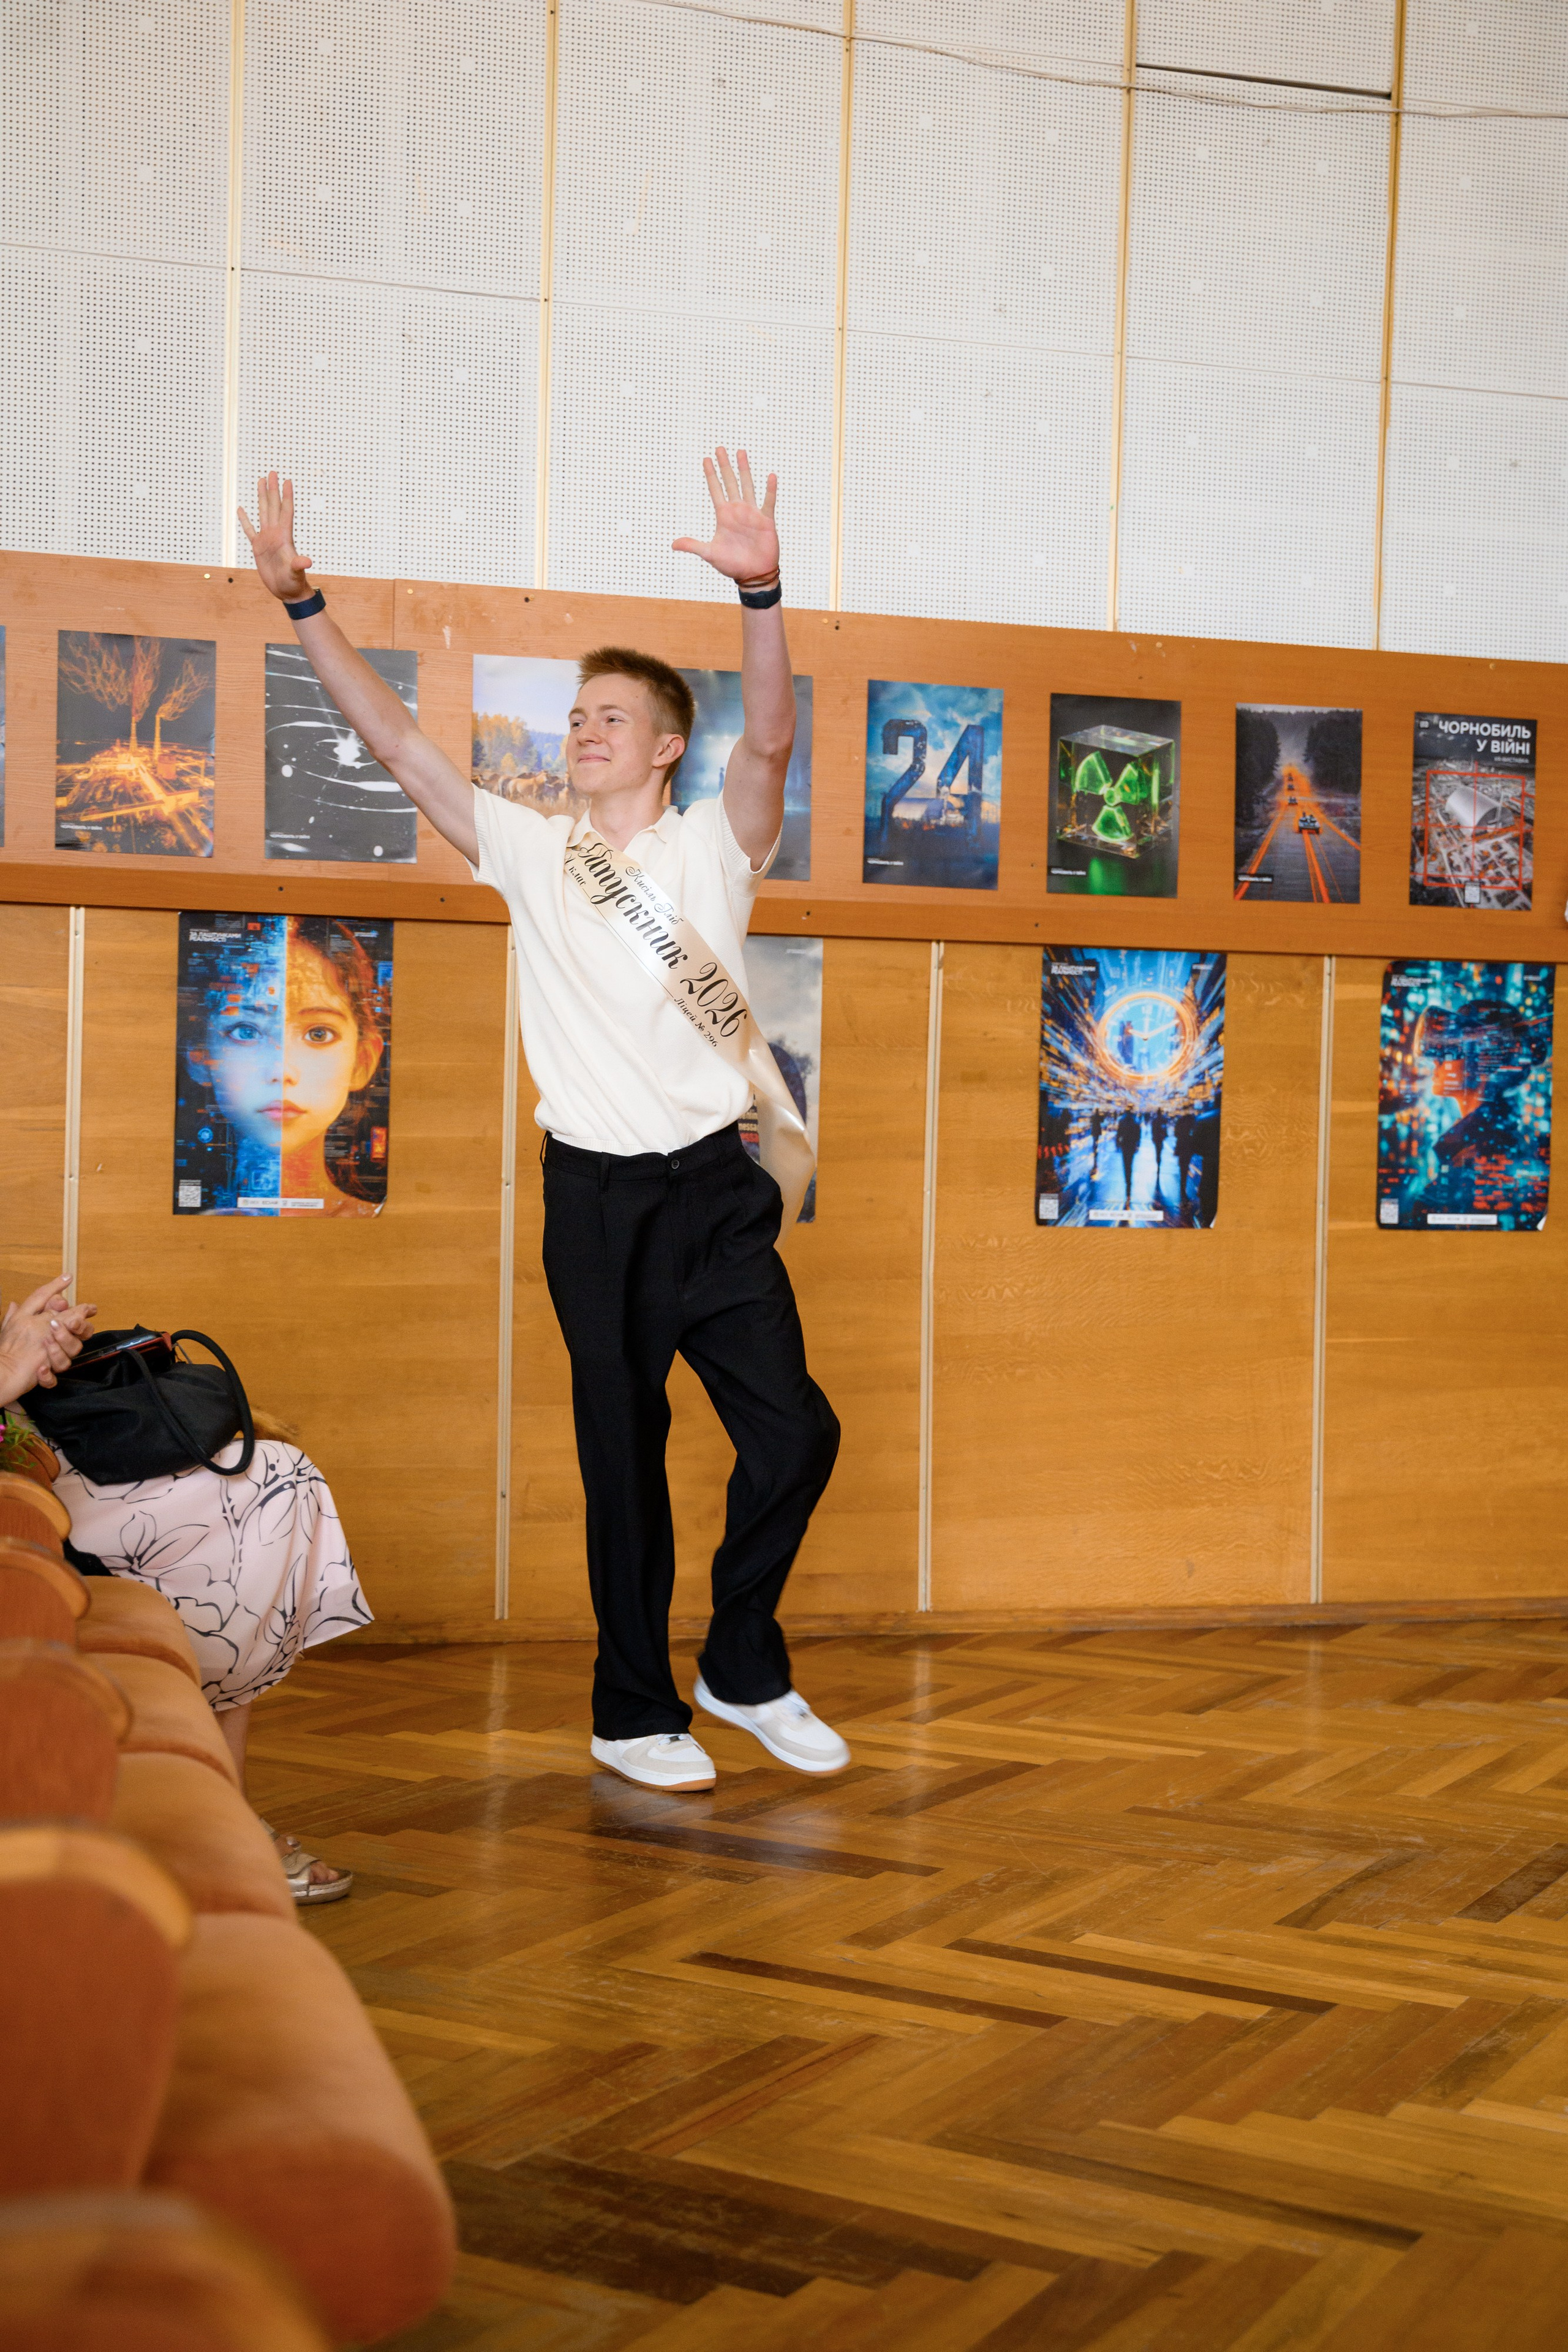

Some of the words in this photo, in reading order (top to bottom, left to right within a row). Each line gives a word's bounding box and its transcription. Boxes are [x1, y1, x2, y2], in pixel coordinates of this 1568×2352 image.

[1439, 720, 1531, 739] ЧОРНОБИЛЬ
[1476, 739, 1488, 753] У
[1491, 738, 1530, 755] ВІЙНІ
[881, 718, 984, 844] 24
[568, 865, 586, 886] клас
[625, 866, 657, 902] Кисіль
[679, 962, 747, 1038] 2026
[674, 998, 698, 1022] Ліцей
[695, 1022, 706, 1031] №
[703, 1030, 718, 1047] 296
